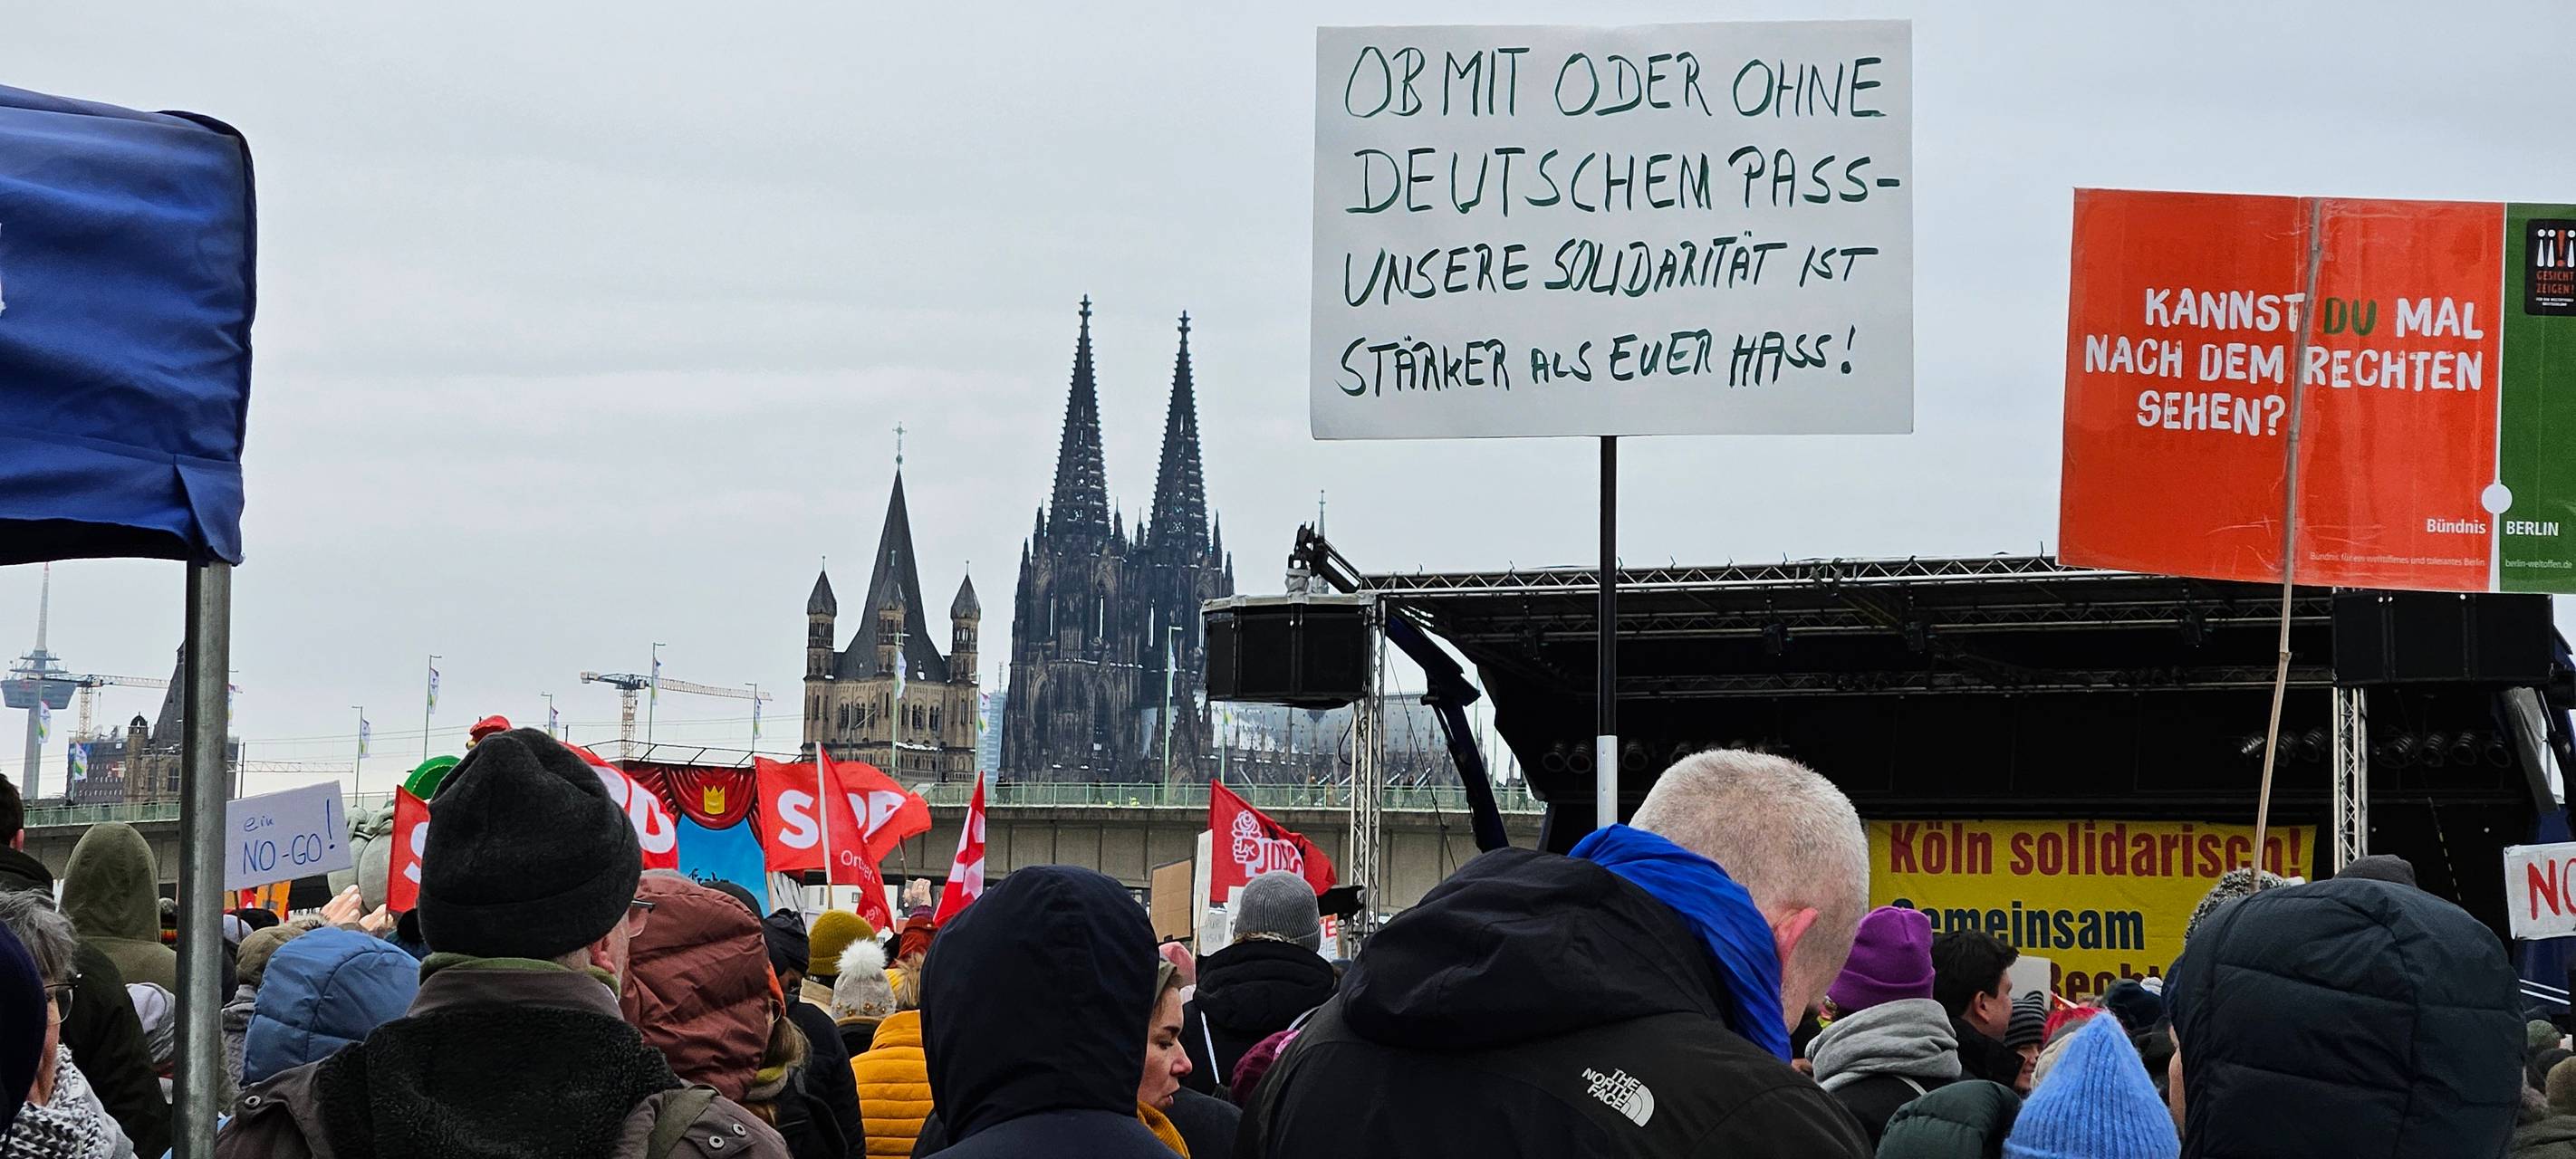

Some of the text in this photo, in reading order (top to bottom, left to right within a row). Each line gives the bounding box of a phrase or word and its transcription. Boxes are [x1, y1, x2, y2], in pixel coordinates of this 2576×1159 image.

[1344, 46, 1887, 118] OB MIT ODER OHNE
[1727, 145, 1900, 209] PASS-
[1344, 230, 1879, 307] UNSERE SOLIDARITÄT IST
[2536, 271, 2575, 282] GESICHT
[2536, 283, 2574, 294] ZEIGEN!
[2145, 287, 2484, 340] KANNST DU MAL
[1530, 340, 1592, 385] ALS
[1610, 328, 1713, 382] EUER
[1729, 324, 1856, 388] HASS!
[2085, 333, 2483, 391] NACH DEM RECHTEN
[2137, 389, 2286, 436] SEHEN?
[2427, 518, 2560, 536] Bündnis BERLIN
[2505, 559, 2572, 569] berlin-weltoffen.de
[1890, 821, 2302, 878] Köln solidarisch!
[1892, 898, 2145, 950] emeinsam
[1581, 1068, 1634, 1101] NORTH
[1587, 1084, 1626, 1111] FACE
[1612, 1068, 1641, 1091] THE
